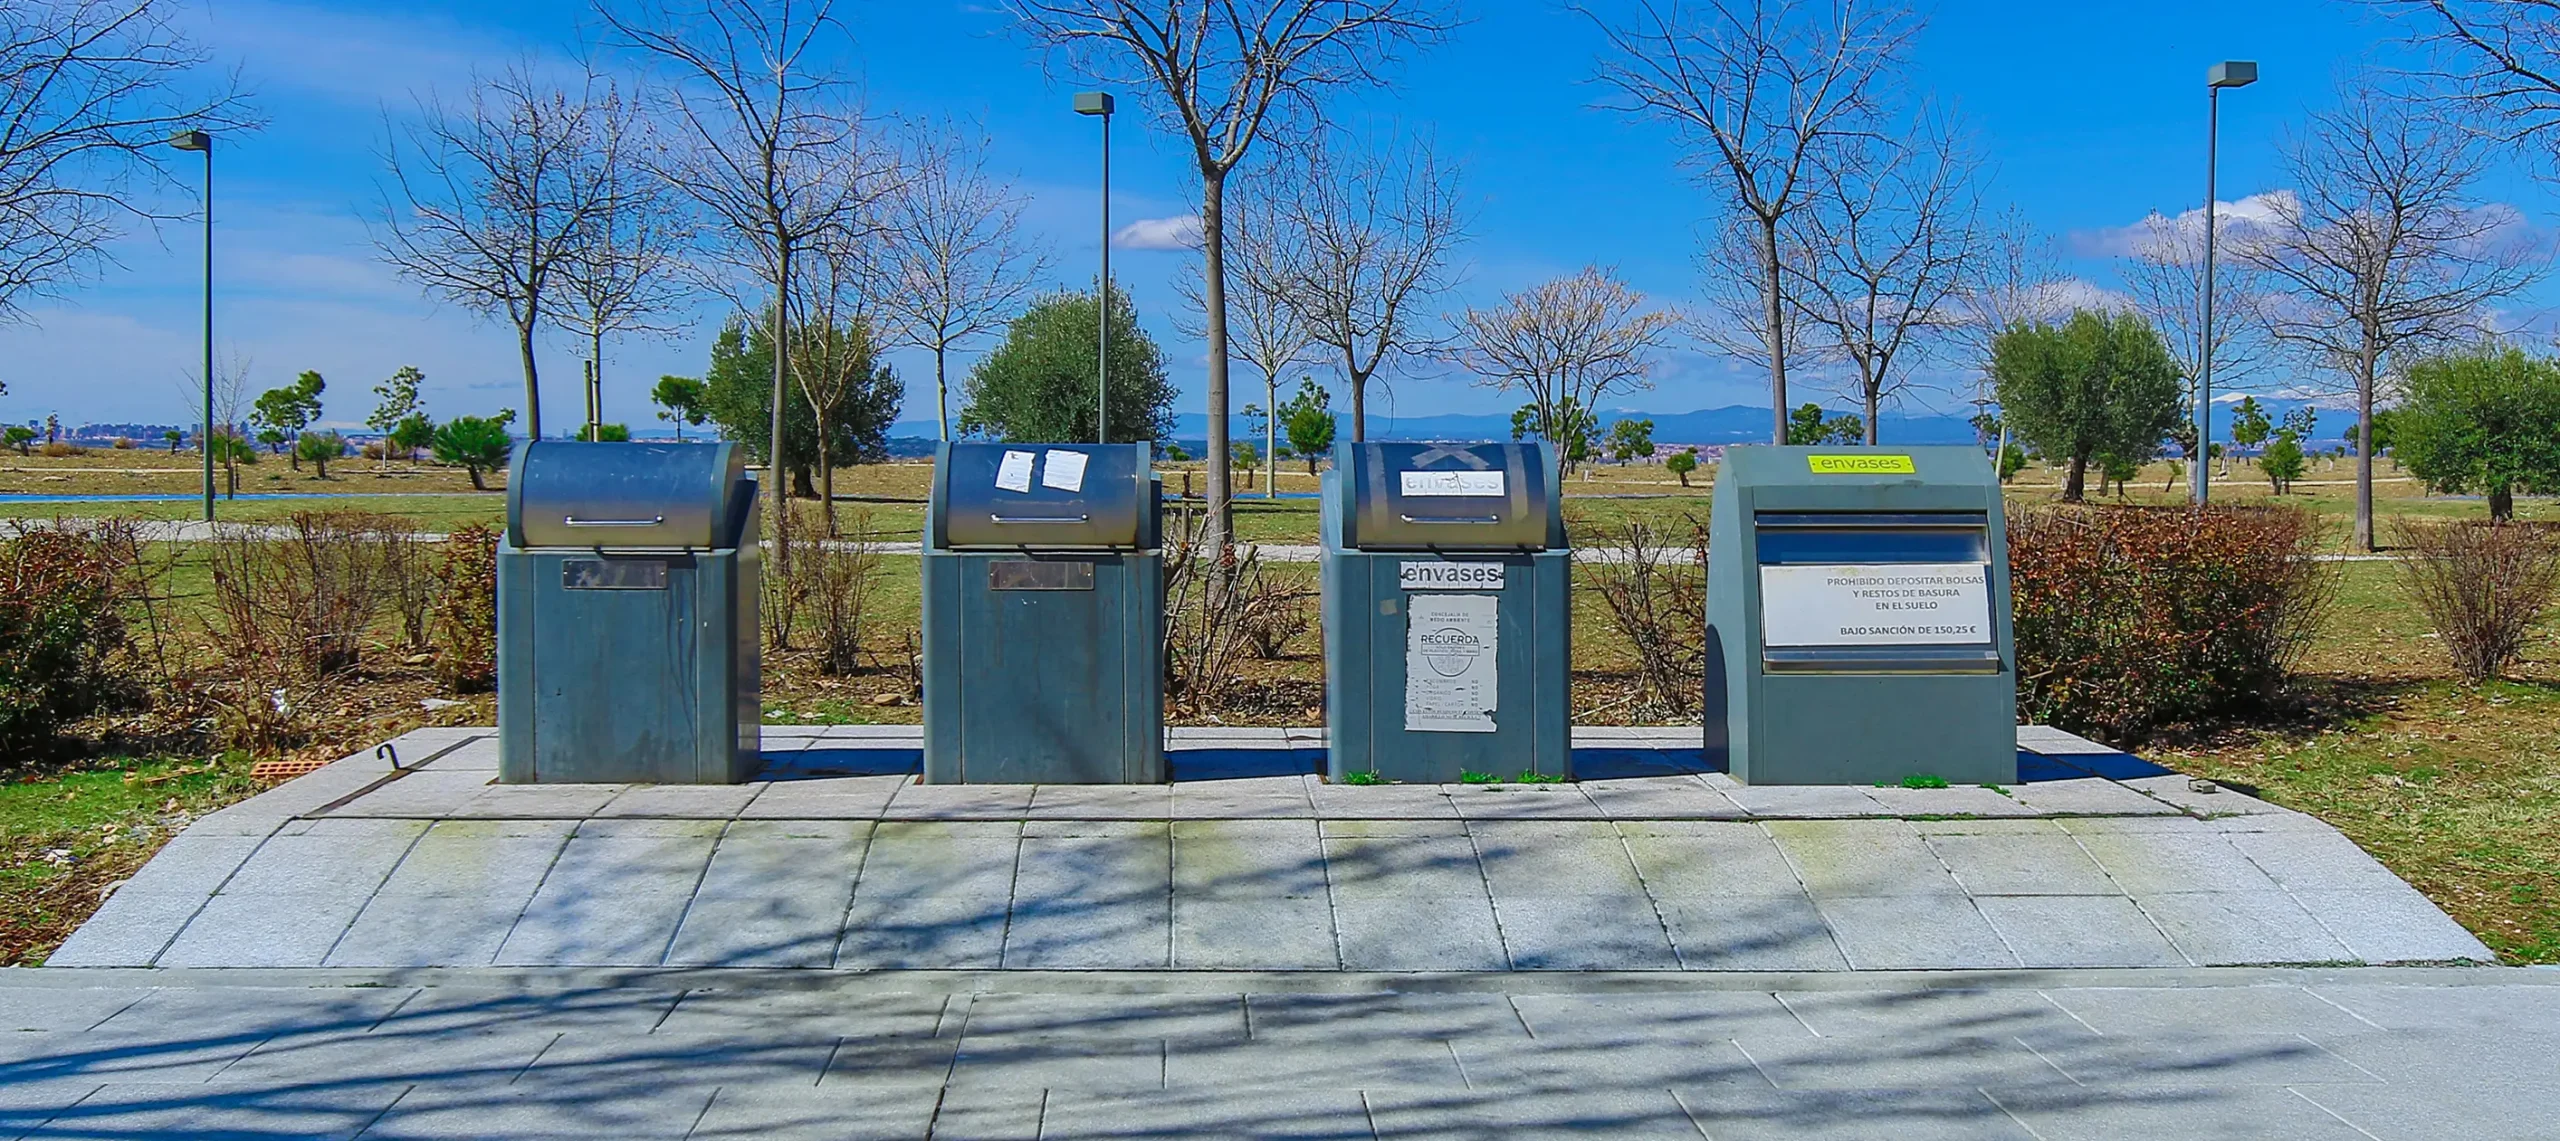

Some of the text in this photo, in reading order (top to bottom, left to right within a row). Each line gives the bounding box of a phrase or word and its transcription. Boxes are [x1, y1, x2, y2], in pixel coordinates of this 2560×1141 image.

[1821, 458, 1902, 469] envases
[1404, 566, 1499, 582] envases
[1827, 576, 1985, 587] PROHIBIDO DEPOSITAR BOLSAS
[1852, 588, 1961, 598] Y RESTOS DE BASURA
[1875, 601, 1938, 610] EN EL SUELO
[1840, 624, 1977, 636] BAJO SANCIÓN DE 150,25 €
[1421, 634, 1480, 644] RECUERDA
